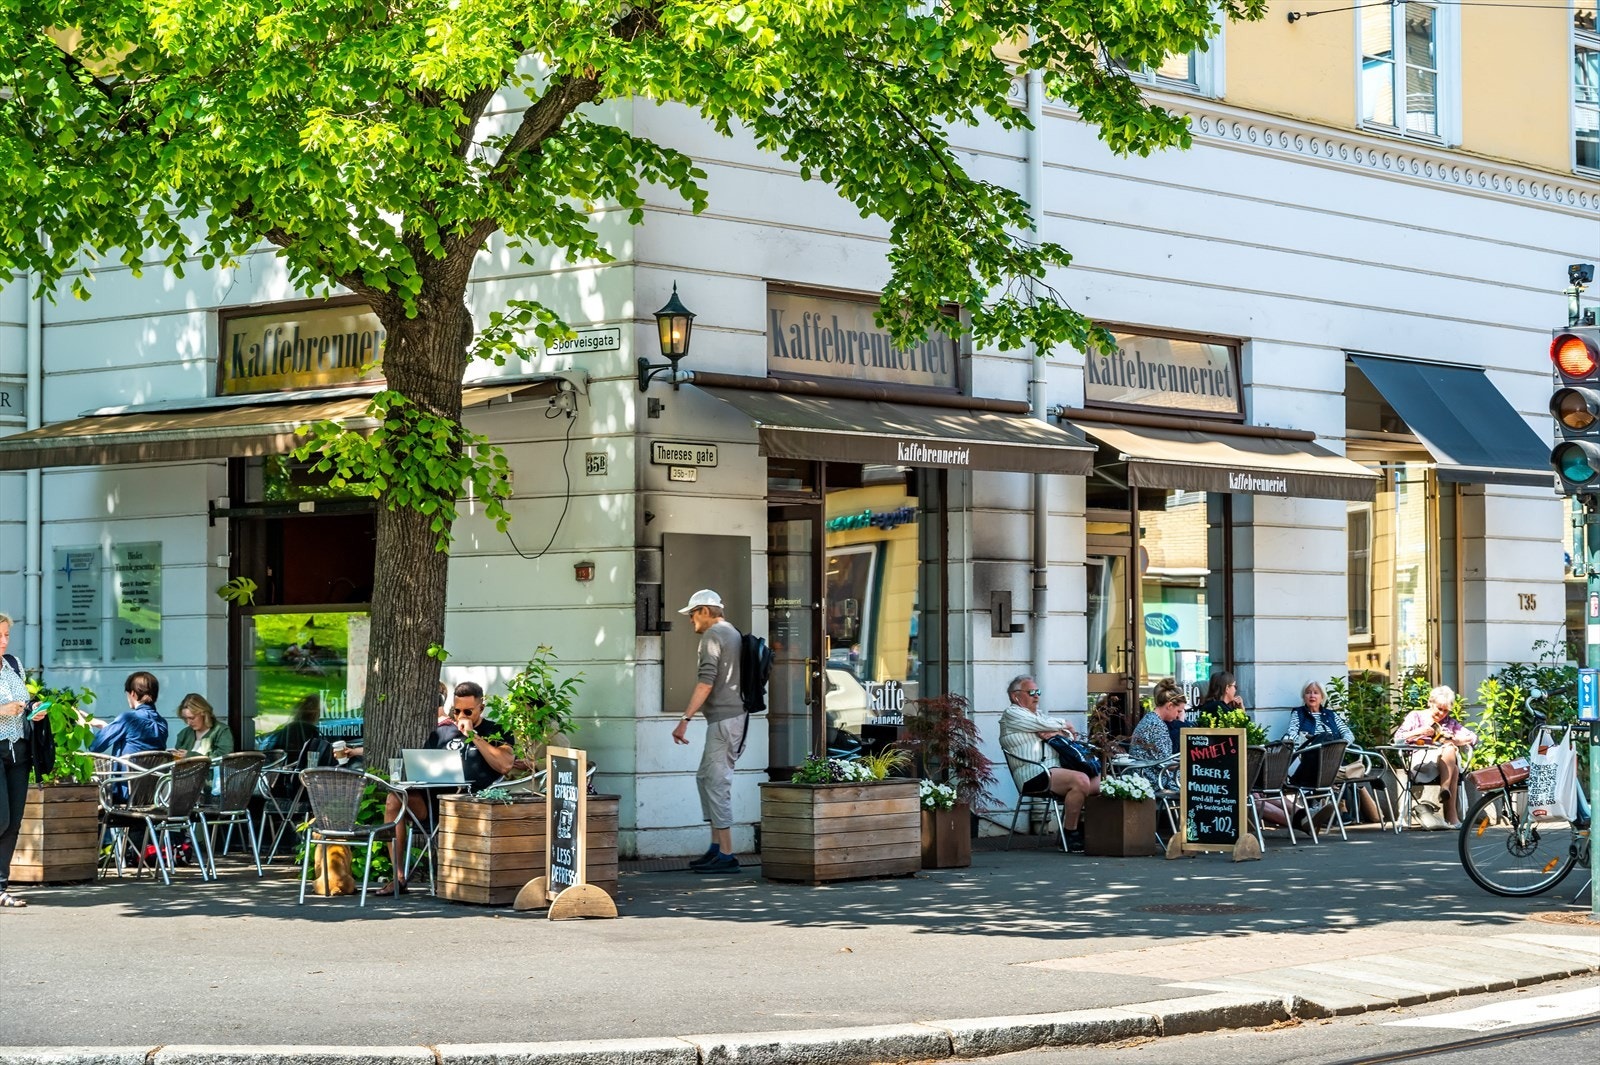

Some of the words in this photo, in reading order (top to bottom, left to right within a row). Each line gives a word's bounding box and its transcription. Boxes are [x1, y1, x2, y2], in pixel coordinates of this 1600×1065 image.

[553, 335, 614, 351] Sporveisgata
[770, 309, 948, 375] Kaffebrenneriet
[231, 326, 386, 379] Kaffebrenner
[1086, 346, 1233, 398] Kaffebrenneriet
[657, 445, 693, 461] Thereses
[696, 450, 714, 464] gate
[897, 441, 970, 465] Kaffebrenneriet
[587, 456, 606, 473] 35B
[672, 468, 695, 479] 35b-17
[1228, 471, 1288, 493] Kaffebrenneriet
[1517, 593, 1537, 611] T35
[865, 680, 905, 711] Kaffe
[558, 771, 573, 784] MORE
[1192, 764, 1222, 778] REKER
[1223, 769, 1231, 780] &
[554, 785, 579, 801] ESPRESSO
[1188, 781, 1229, 795] MAJONES
[556, 847, 572, 866] LESS
